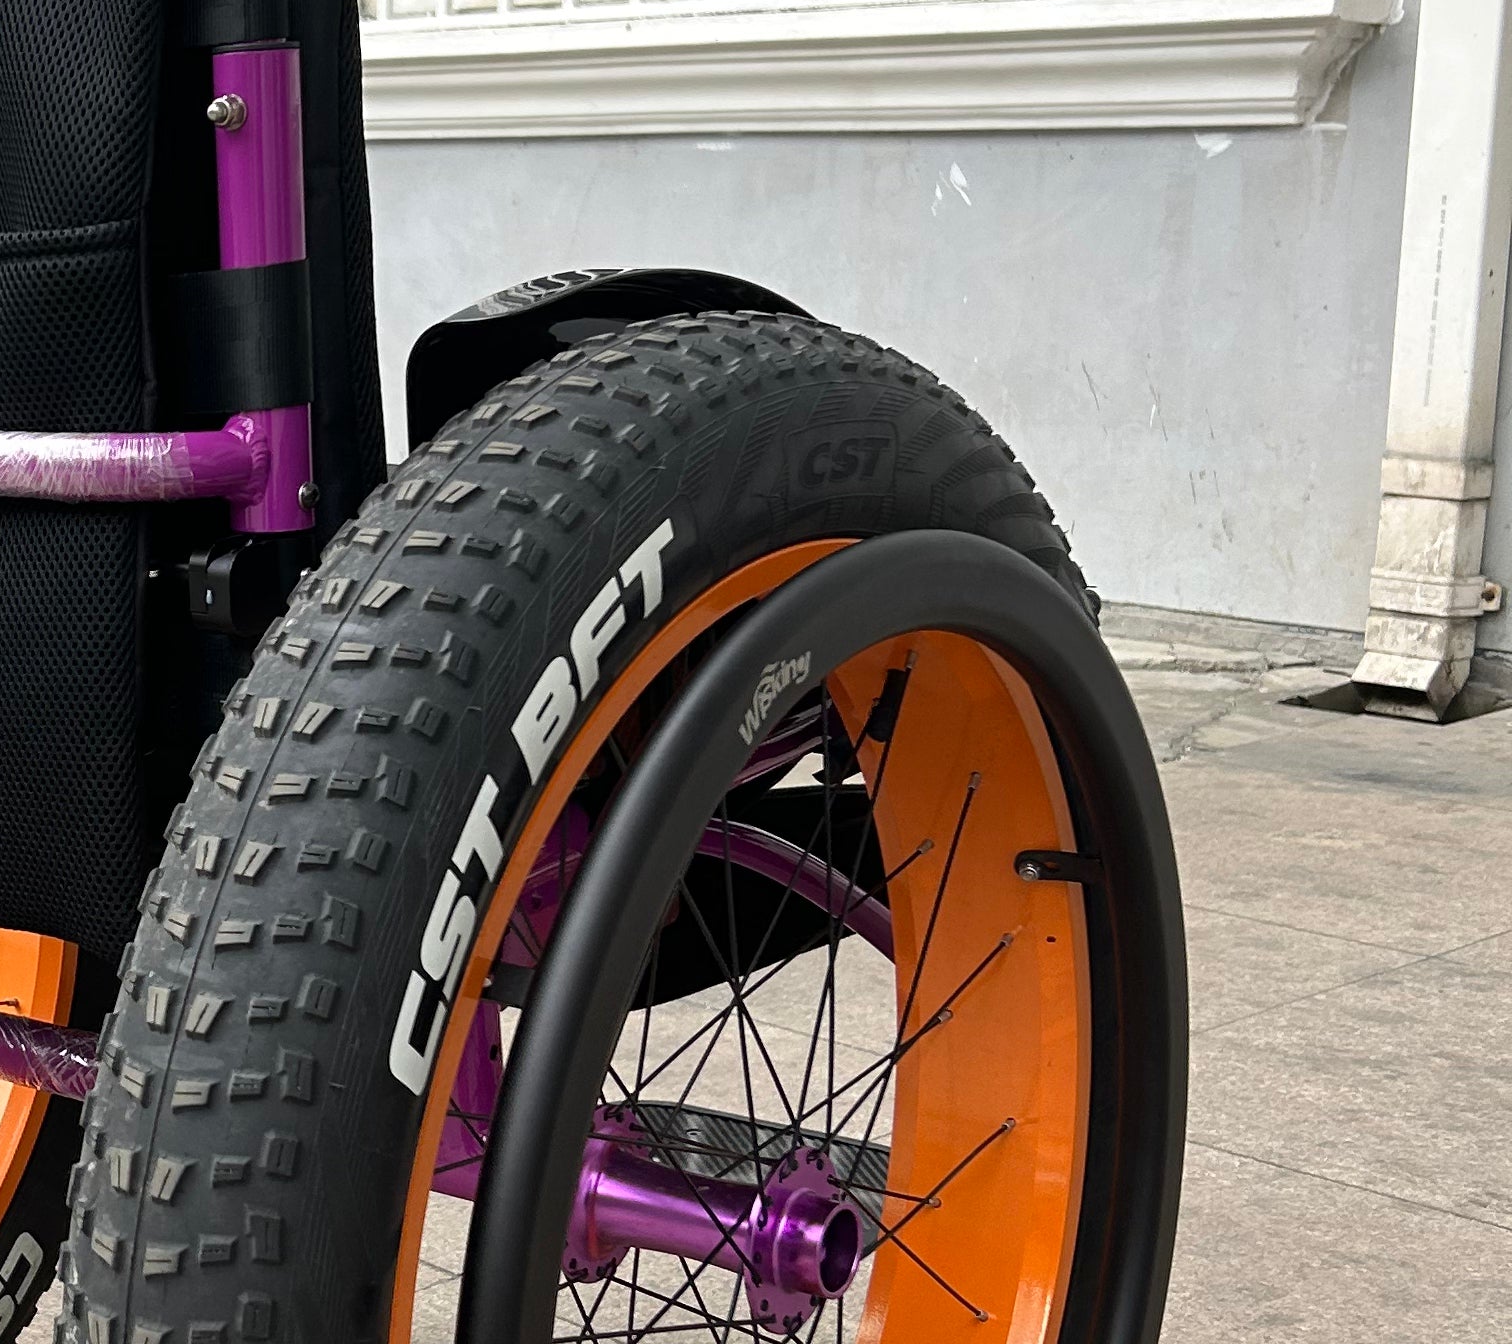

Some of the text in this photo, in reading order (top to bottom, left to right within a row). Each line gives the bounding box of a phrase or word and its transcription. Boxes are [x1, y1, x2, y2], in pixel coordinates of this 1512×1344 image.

[798, 436, 891, 489] CST
[389, 518, 676, 1097] CST BFT
